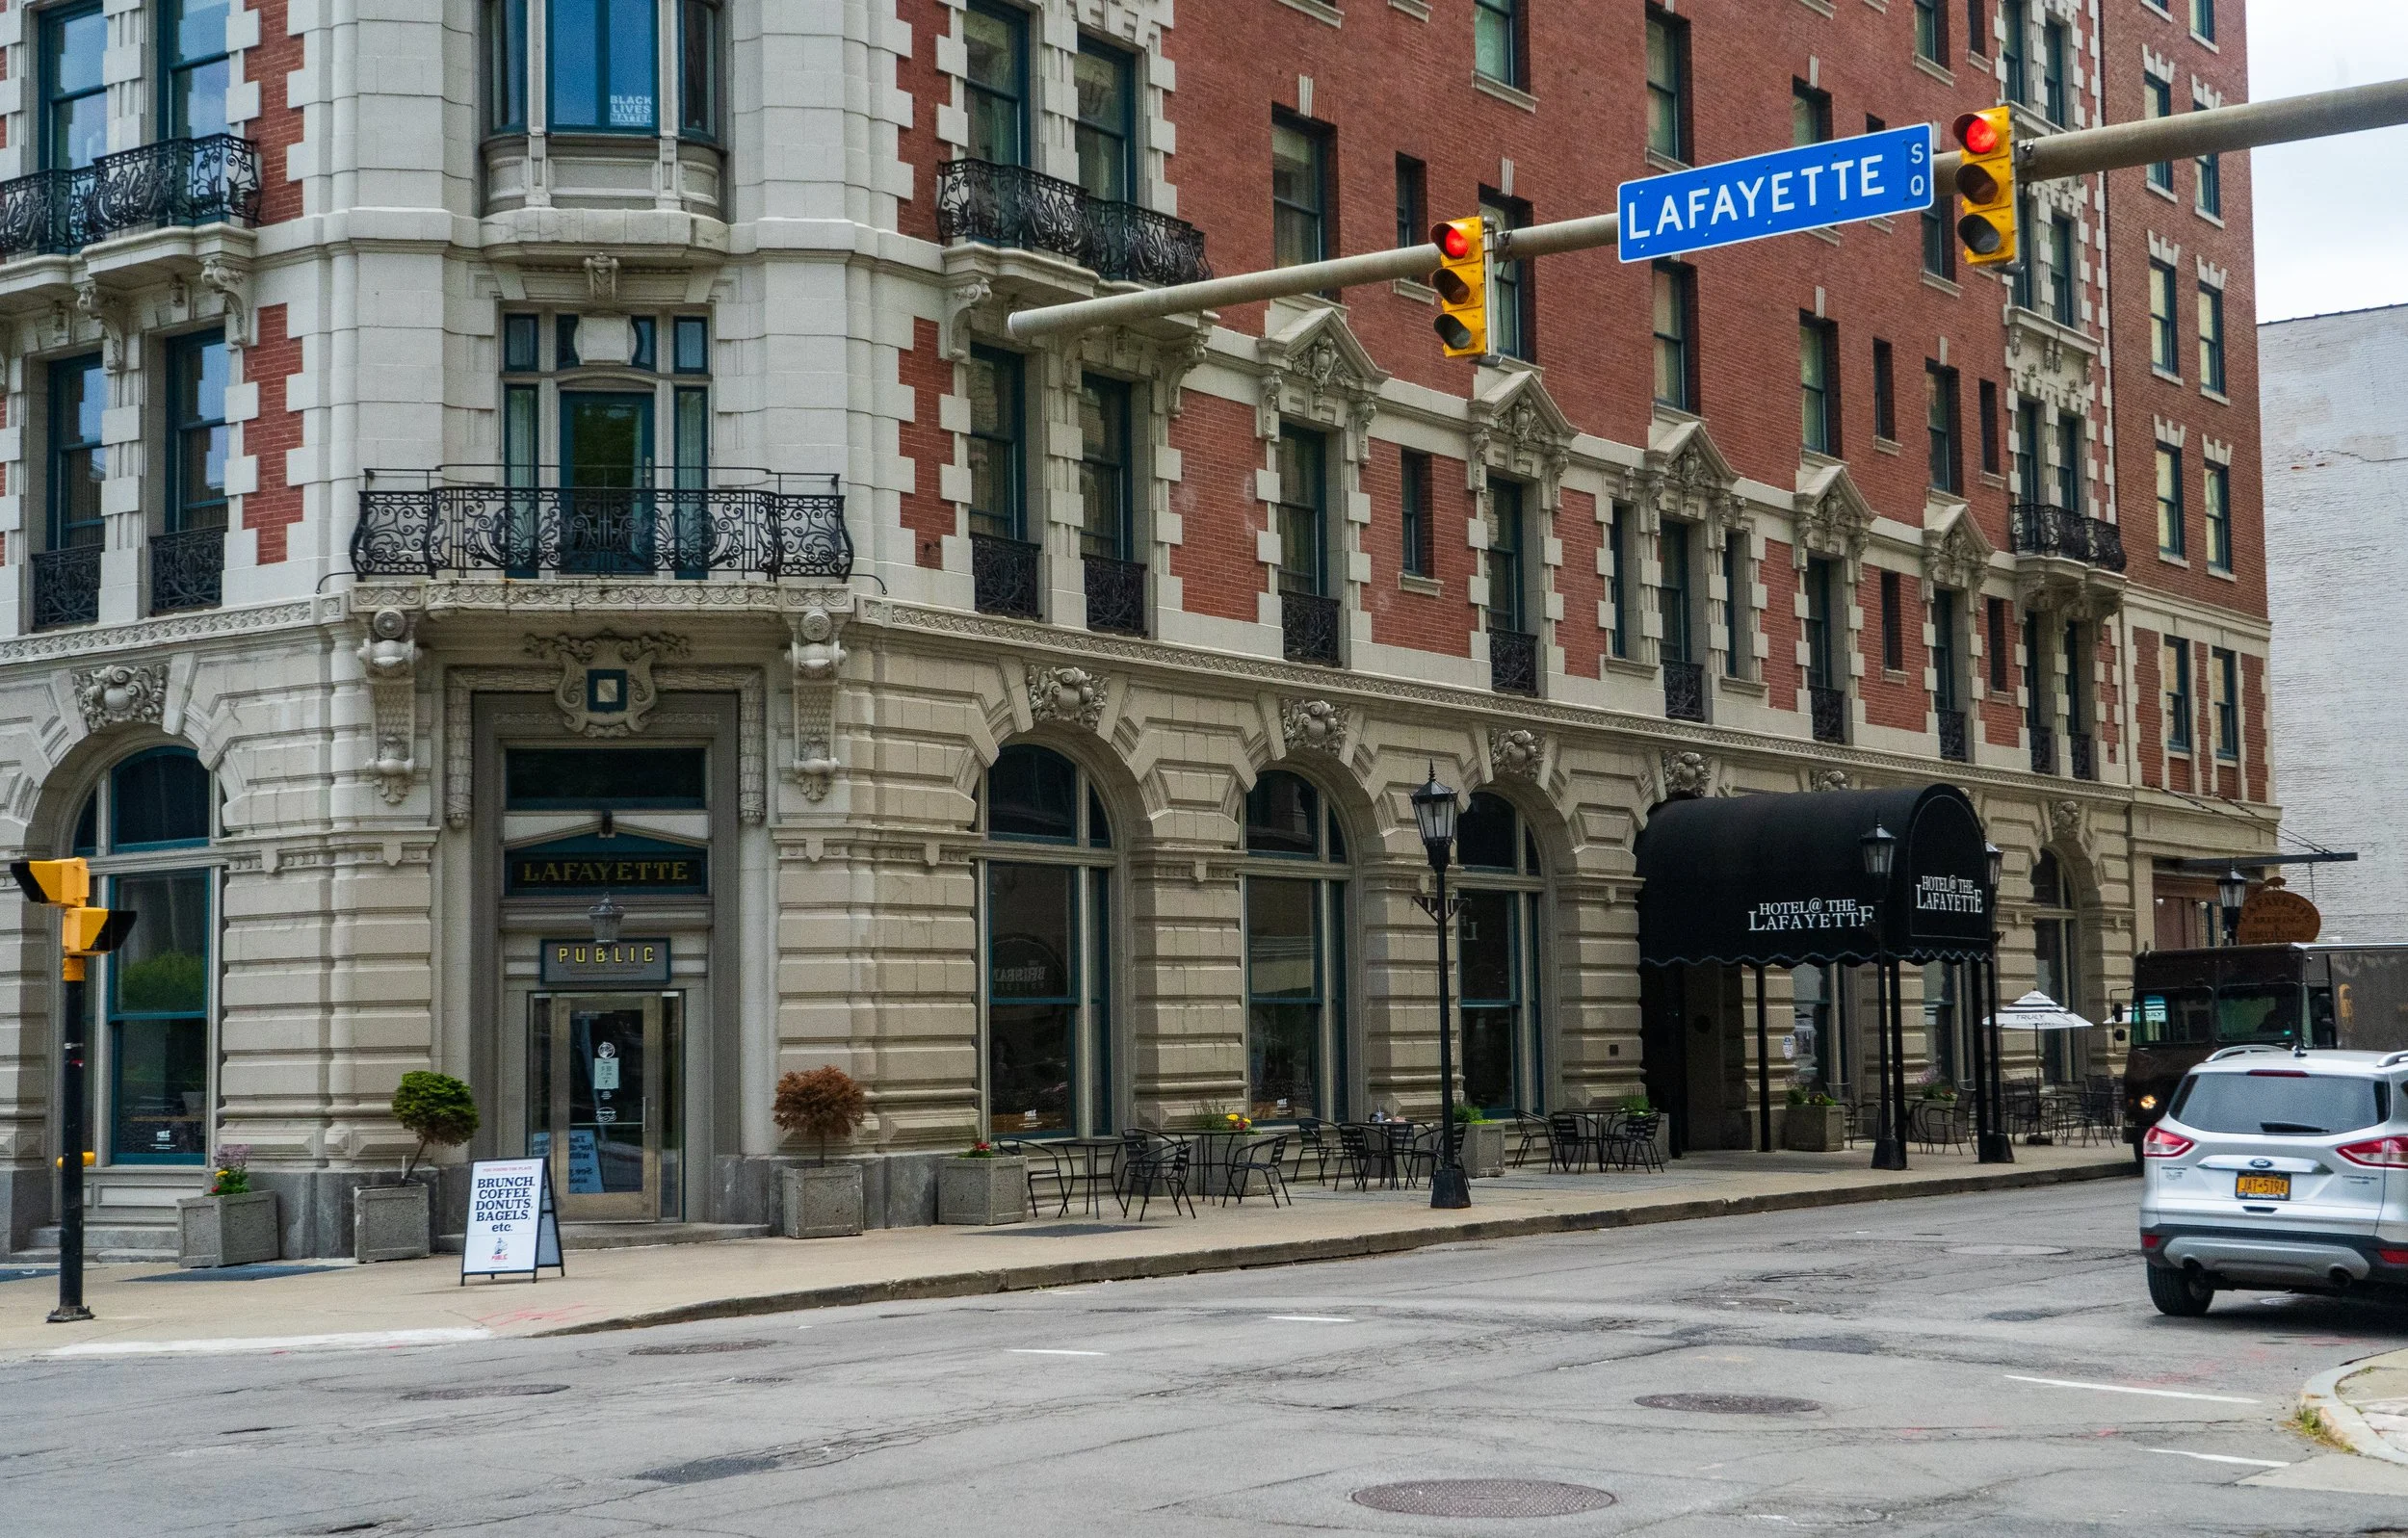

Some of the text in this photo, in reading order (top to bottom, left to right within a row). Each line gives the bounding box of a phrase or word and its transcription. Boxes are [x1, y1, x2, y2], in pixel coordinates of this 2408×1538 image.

[610, 95, 652, 104] BLACK
[612, 105, 652, 114] LIVES
[610, 114, 652, 122] MATTER
[1628, 154, 1885, 240] LAFAYETTE
[523, 862, 689, 881] LAFAYETTE
[1957, 878, 1974, 894] THE
[1825, 899, 1857, 913] THE
[1915, 884, 1983, 914] LAFAYETTE
[1747, 905, 1875, 931] LAFAYETTE
[559, 947, 654, 962] PUBLIC
[491, 1222, 513, 1232] etc.
